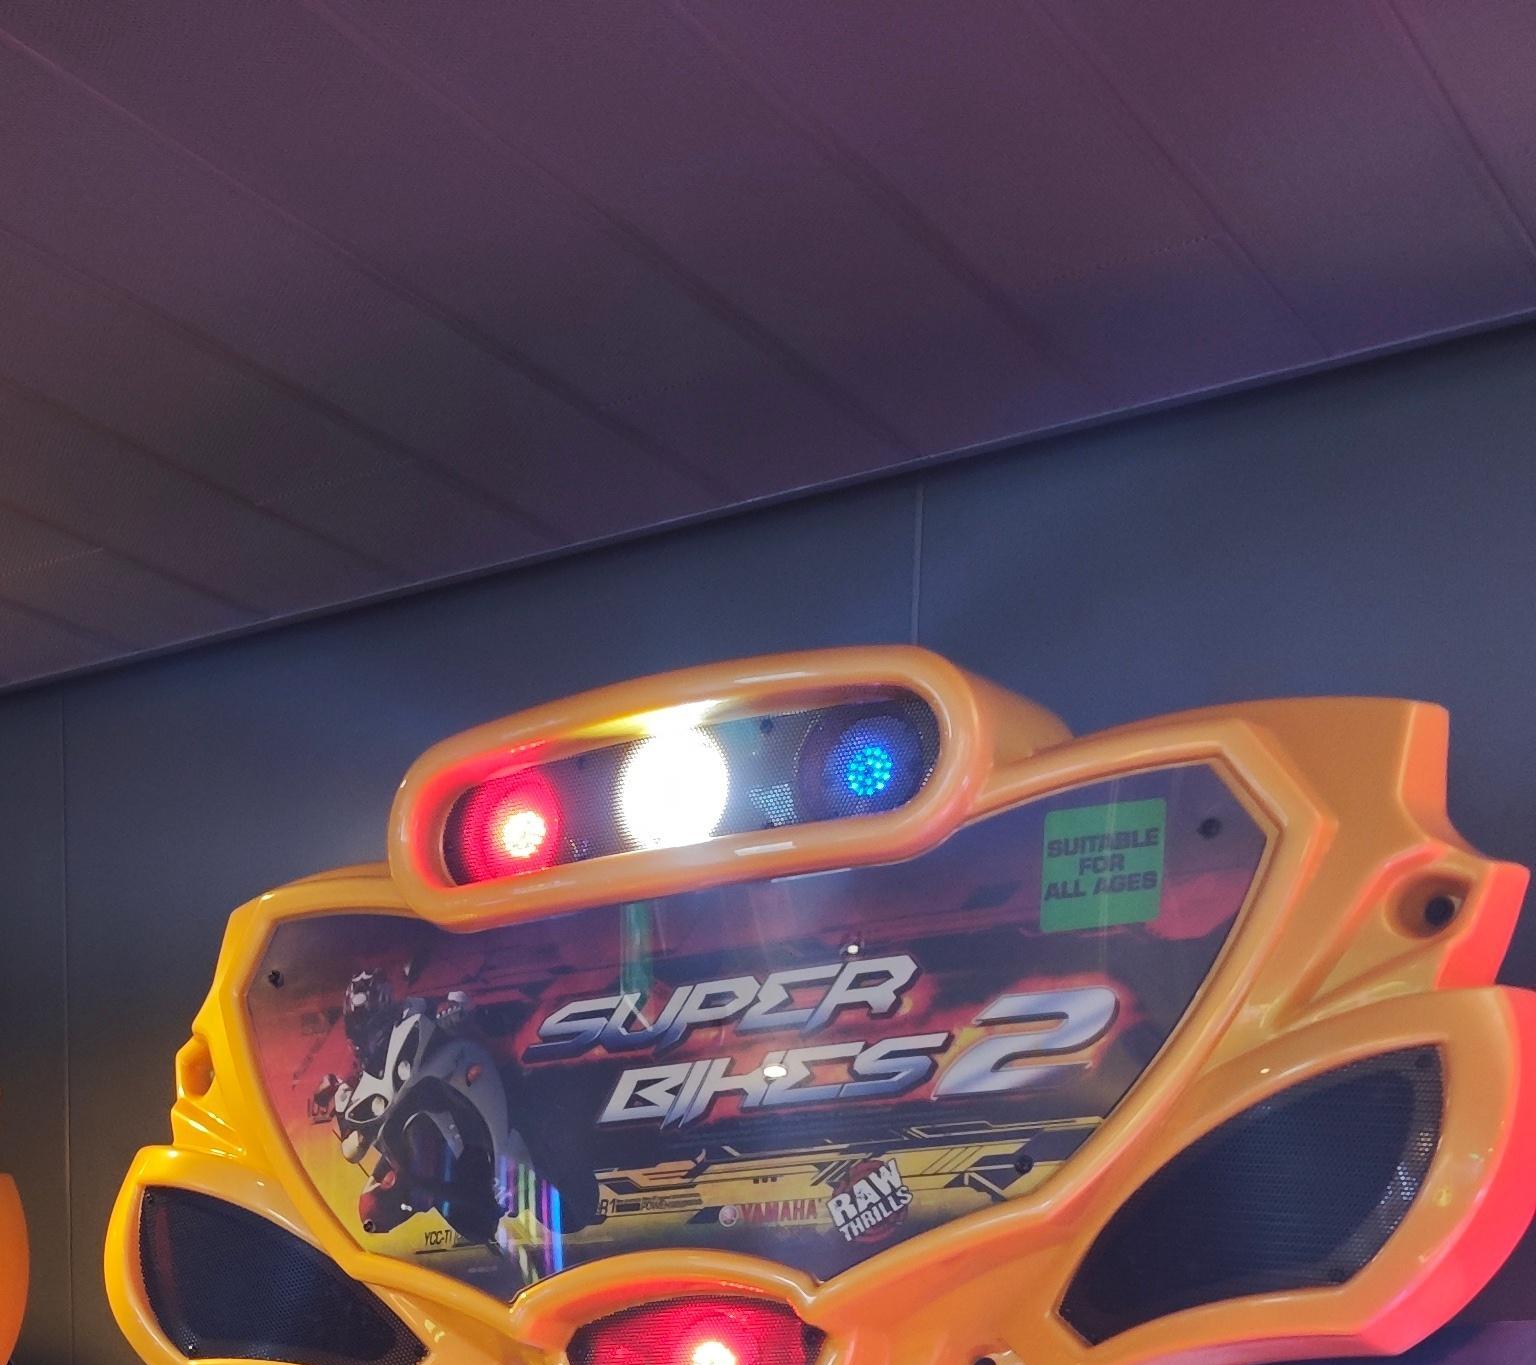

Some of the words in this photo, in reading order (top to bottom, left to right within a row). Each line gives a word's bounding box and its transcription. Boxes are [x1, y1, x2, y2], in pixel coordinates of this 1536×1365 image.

[1047, 827, 1159, 858] SUITABLE
[1044, 879, 1086, 901] ALL
[1093, 870, 1158, 895] AGES
[1078, 853, 1125, 876] FOR
[523, 954, 920, 1062] SUPER
[598, 1032, 952, 1129] BIKES
[933, 986, 1119, 1100] 2
[740, 1200, 817, 1222] YAMAHA
[827, 1158, 903, 1227] RAW
[839, 1186, 913, 1241] THRILLS
